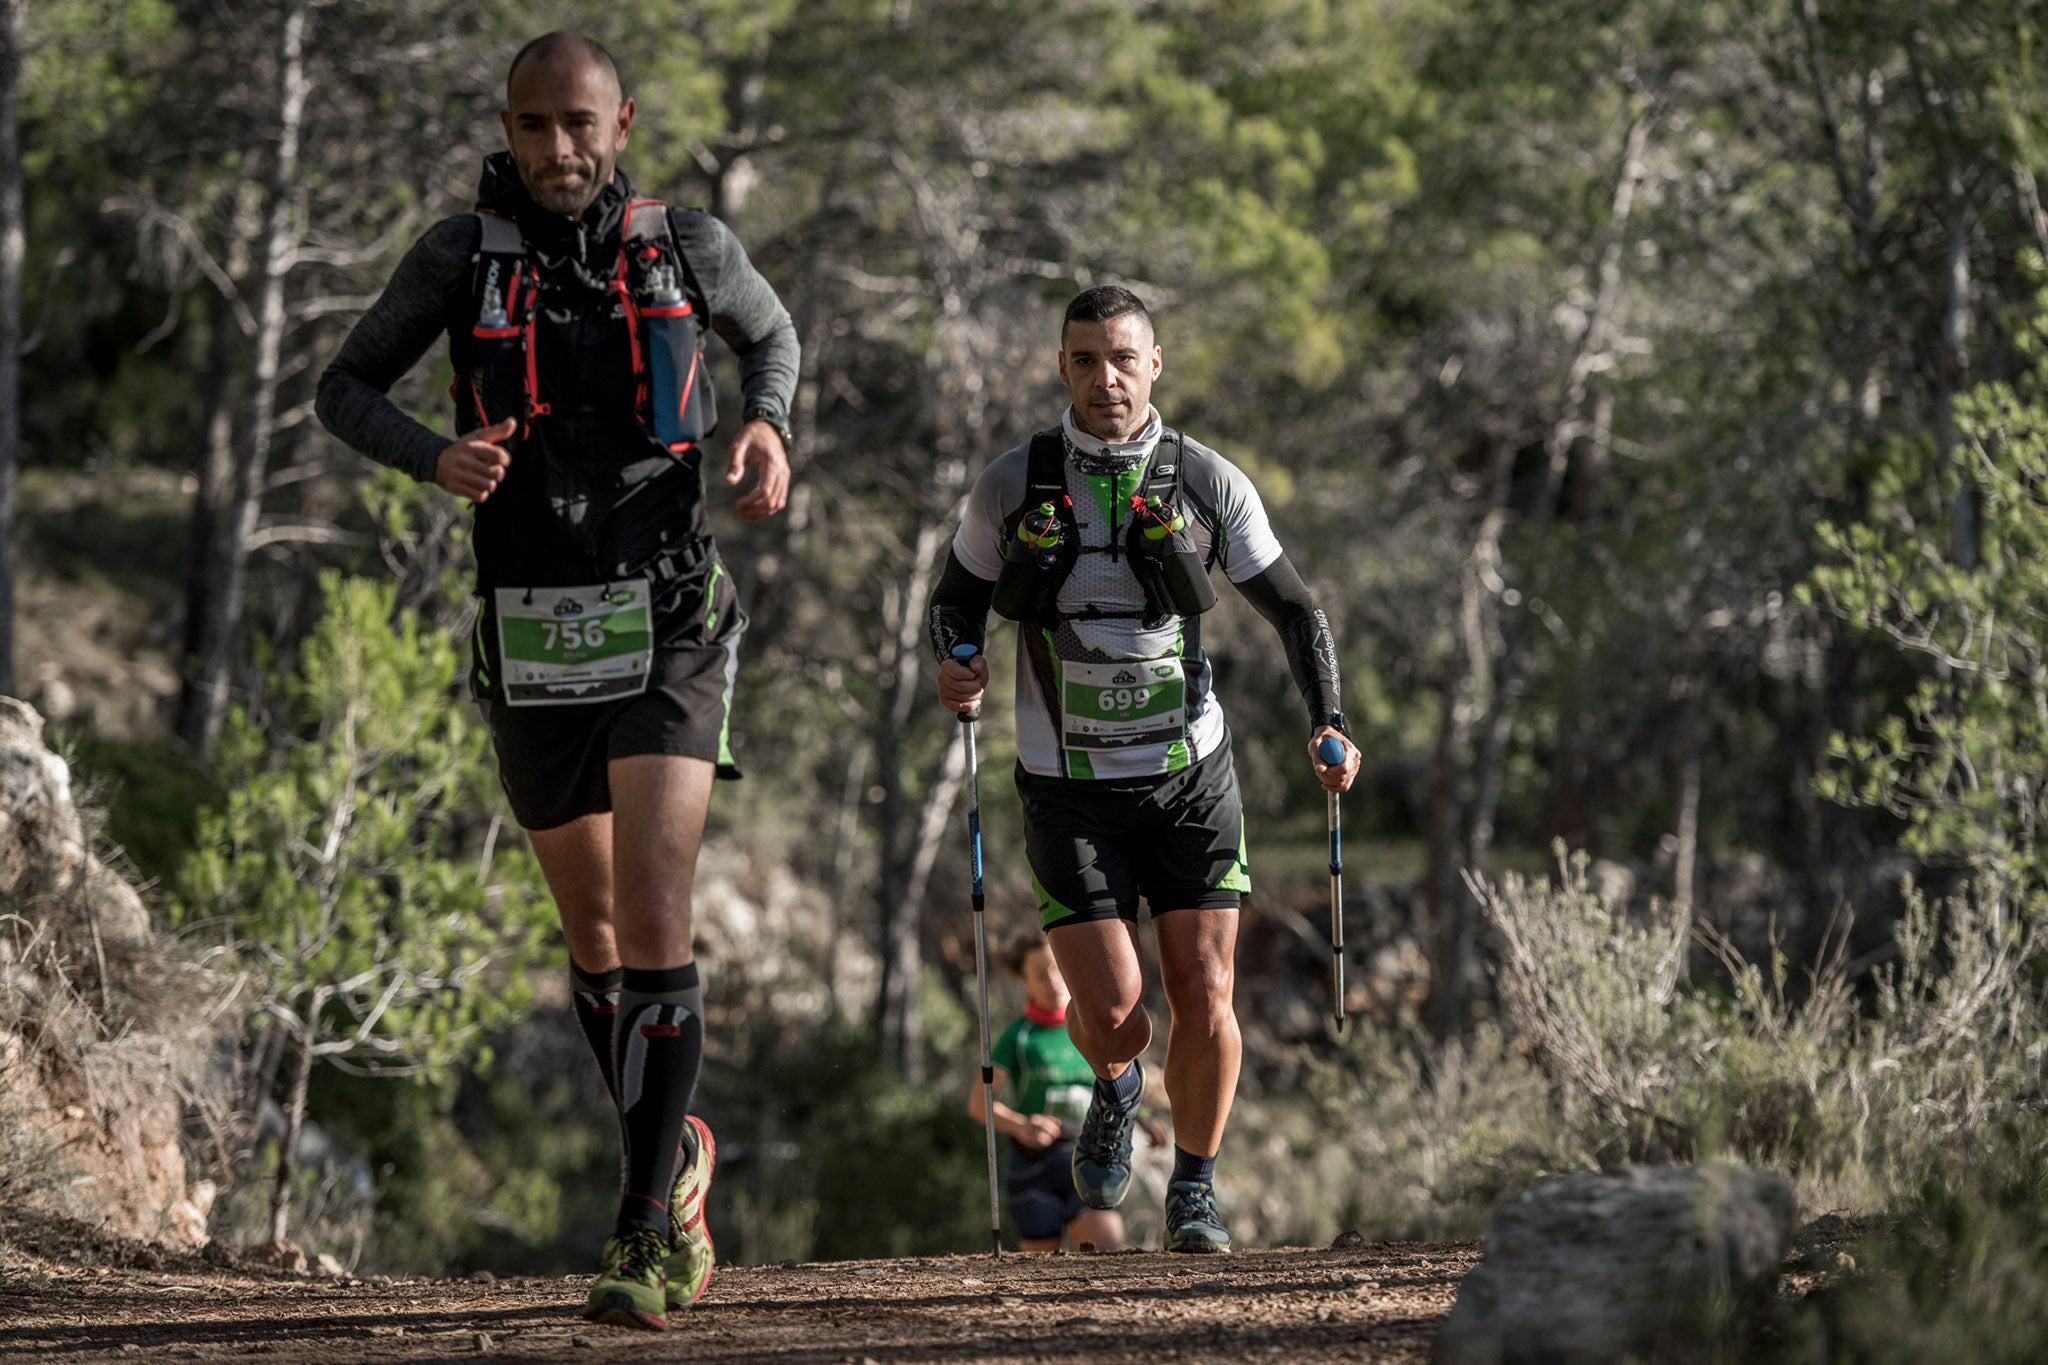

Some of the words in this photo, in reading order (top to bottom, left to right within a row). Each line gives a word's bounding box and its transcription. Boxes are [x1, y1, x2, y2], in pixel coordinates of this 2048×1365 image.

[541, 619, 605, 650] 756
[1322, 628, 1340, 695] penyagolosa
[1098, 688, 1150, 711] 699
